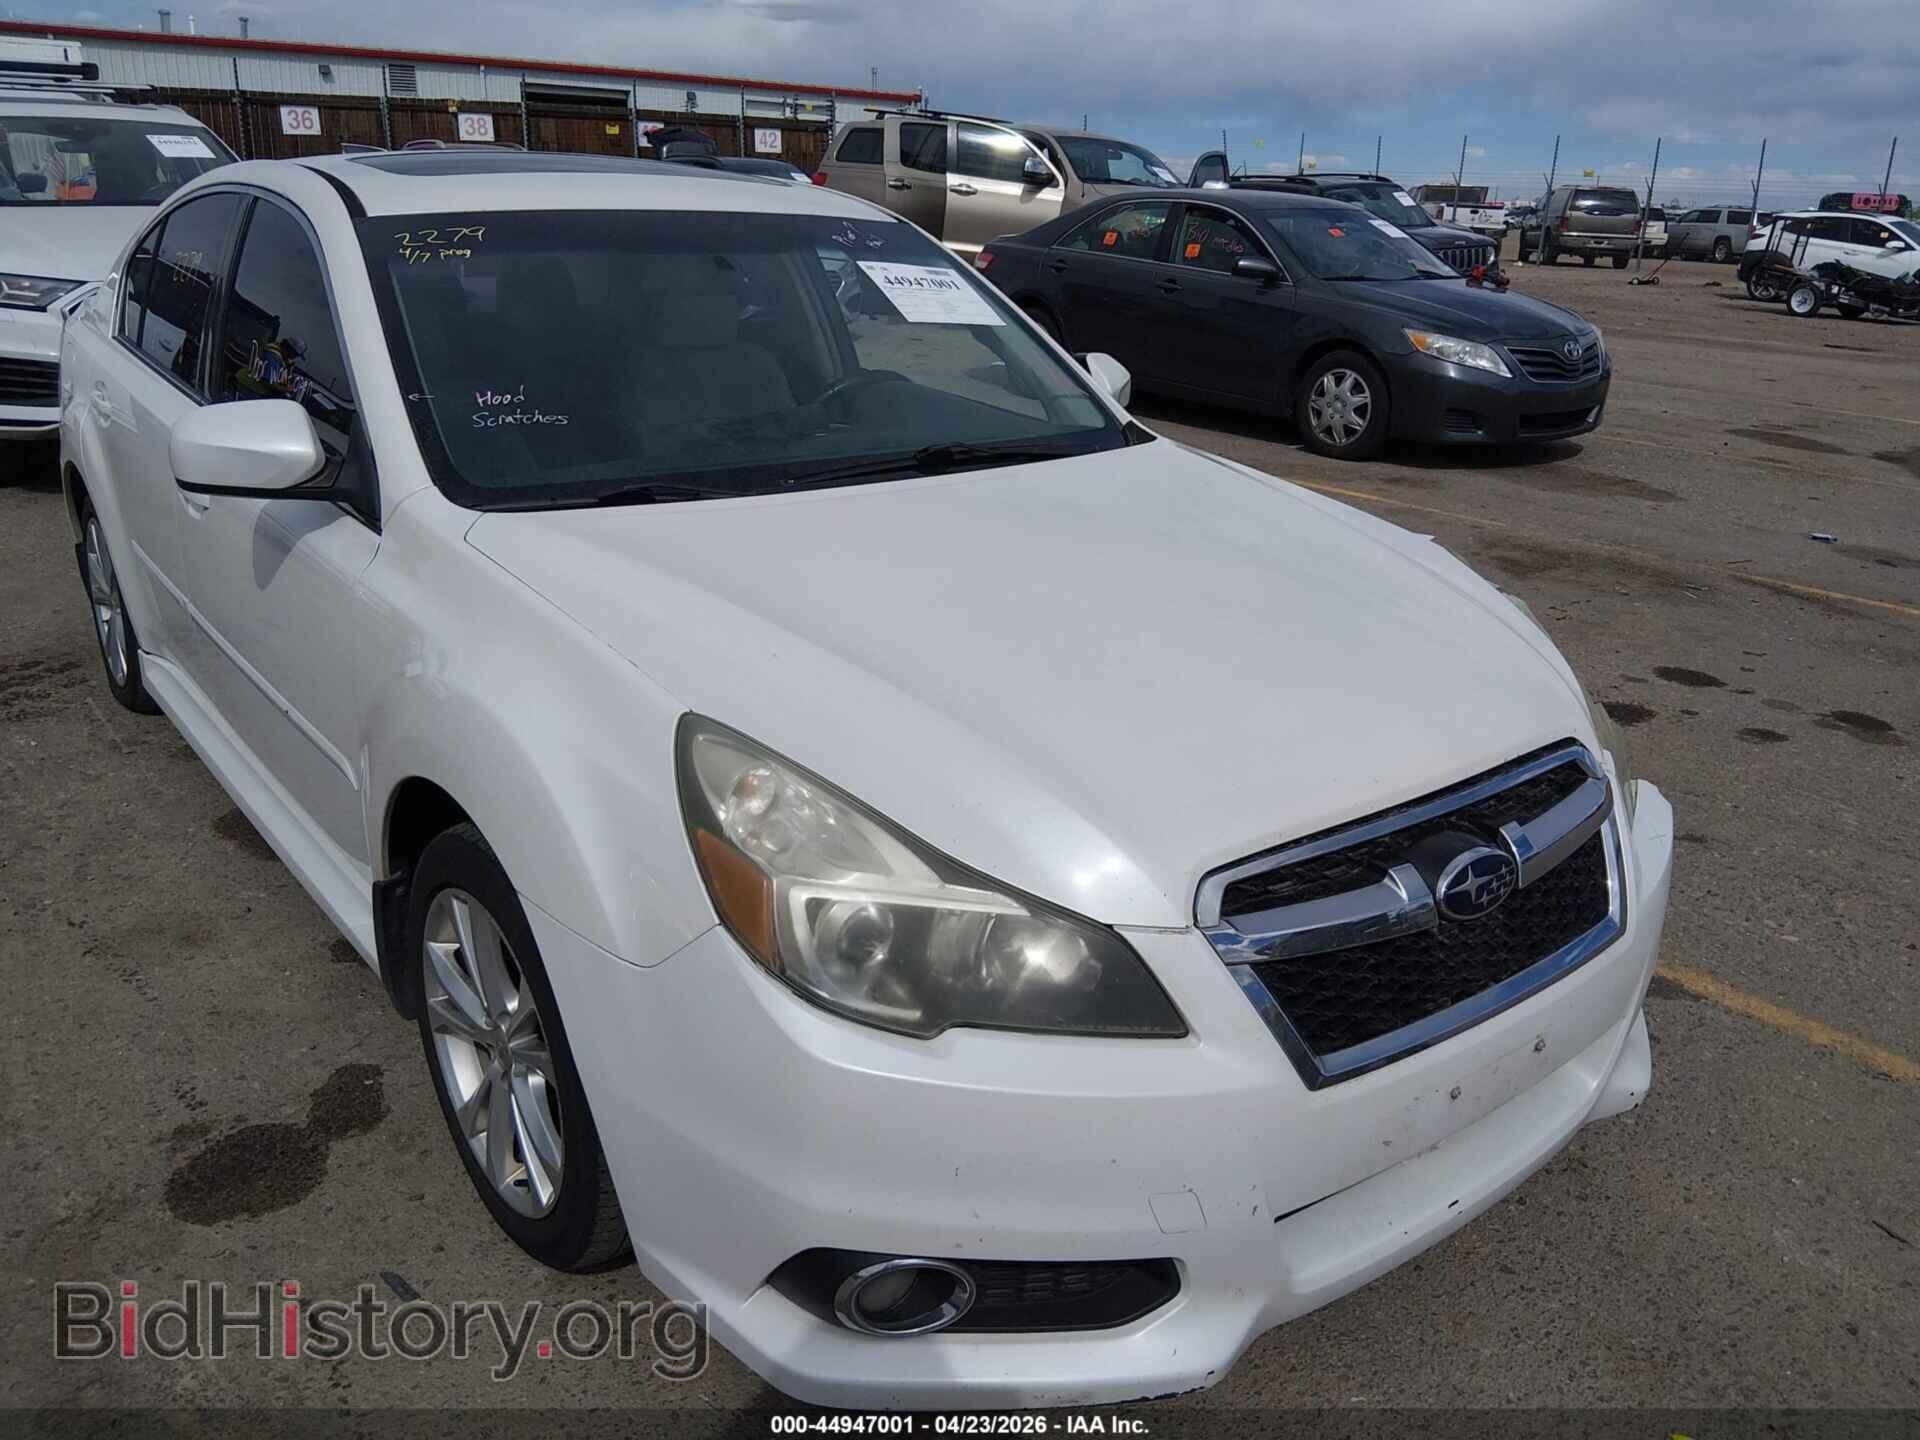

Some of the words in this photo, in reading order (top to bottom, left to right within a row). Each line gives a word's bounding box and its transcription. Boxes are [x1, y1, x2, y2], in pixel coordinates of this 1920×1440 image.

[287, 109, 314, 130] 36
[464, 116, 489, 137] 38
[759, 131, 778, 149] 42
[394, 225, 485, 246] 2279
[883, 274, 961, 291] 44947001
[475, 384, 525, 407] Hood
[472, 408, 569, 428] Scratches
